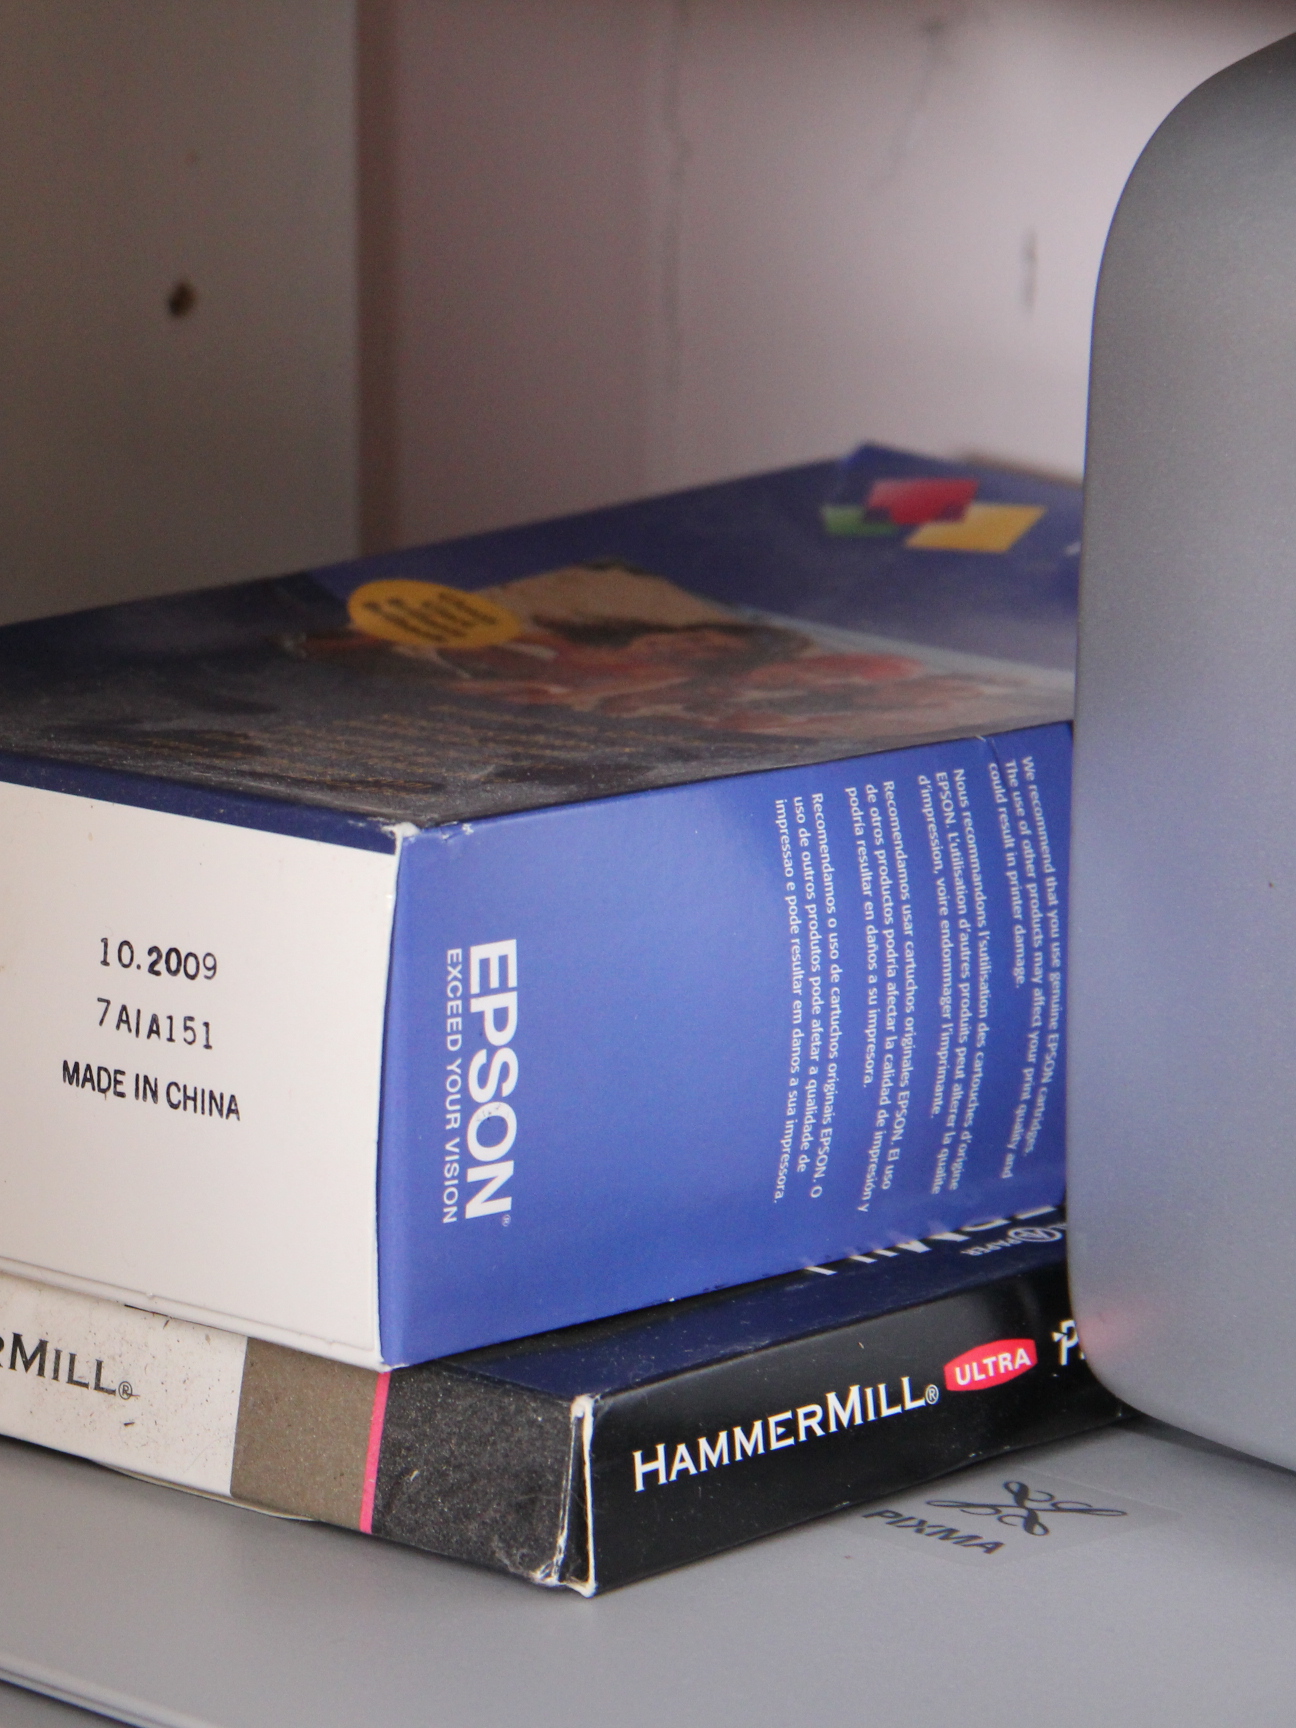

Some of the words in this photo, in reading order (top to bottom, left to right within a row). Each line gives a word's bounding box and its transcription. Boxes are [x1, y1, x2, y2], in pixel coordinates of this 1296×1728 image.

[952, 767, 969, 808] Nous
[987, 761, 1008, 804] could
[1004, 758, 1018, 787] The
[1020, 755, 1036, 781] We
[792, 795, 805, 824] uso
[843, 786, 865, 836] podría
[864, 783, 878, 803] de
[1011, 791, 1025, 816] use
[797, 827, 811, 847] de
[869, 806, 884, 846] otros
[882, 779, 910, 901] Recomendamos
[996, 806, 1015, 849] result
[1018, 820, 1032, 835] of
[1028, 784, 1055, 874] recommend
[811, 792, 835, 914] Recomendamos
[855, 839, 872, 897] resultar
[962, 810, 986, 928] recommandons
[1004, 851, 1017, 867] in
[1022, 839, 1036, 878] other
[785, 881, 796, 891] e
[801, 850, 815, 900] outros
[873, 849, 893, 925] productos
[1004, 869, 1022, 920] printer
[1044, 875, 1058, 906] that
[783, 894, 802, 934] pode
[862, 900, 874, 921] en
[934, 877, 950, 916] voire
[1025, 882, 1043, 948] products
[804, 903, 822, 972] produtos
[826, 917, 837, 929] o
[900, 903, 913, 937] usar
[1046, 909, 1058, 938] you
[100, 937, 217, 980] 10.2009
[827, 931, 839, 960] uso
[864, 924, 879, 971] daños
[881, 928, 898, 978] podría
[1011, 923, 1026, 989] damage.
[1050, 942, 1060, 967] use
[790, 938, 804, 996] resultar
[829, 963, 843, 983] de
[866, 974, 878, 984] a
[903, 940, 917, 1013] cartuchos
[938, 918, 953, 1019] endommager
[1030, 951, 1043, 983] may
[446, 948, 463, 1051] EXCEED
[791, 999, 802, 1024] em
[808, 975, 824, 1015] pode
[866, 986, 878, 1005] su
[885, 981, 899, 1032] afectar
[957, 982, 972, 1043] produits
[1029, 987, 1045, 1028] affect
[1048, 972, 1060, 1029] genuine
[809, 1018, 823, 1062] afetar
[827, 986, 842, 1059] cartuchos
[883, 1035, 898, 1050] la
[975, 1021, 990, 1048] des
[789, 1027, 804, 1074] danos
[862, 1008, 880, 1088] impresora.
[899, 1016, 916, 1088] originales
[954, 1046, 966, 1079] peut
[1025, 1030, 1039, 1063] your
[1040, 1033, 1058, 1084] EPSON
[62, 1059, 126, 1098] MADE
[134, 1073, 158, 1104] IN
[165, 1081, 241, 1121] CHINA
[787, 1077, 799, 1087] a
[807, 1065, 818, 1075] a
[877, 1053, 895, 1106] calidad
[963, 1050, 984, 1128] cartouches
[1019, 1066, 1034, 1101] print
[445, 1057, 462, 1130] YOUR
[785, 1089, 798, 1116] sua
[821, 1061, 839, 1125] originais
[800, 1078, 817, 1150] qualidade
[874, 1108, 889, 1127] de
[1006, 1103, 1026, 1150] quality
[886, 1146, 900, 1162] El
[941, 1130, 956, 1145] la
[443, 1137, 461, 1224] VISION
[773, 1118, 797, 1204] impressora.
[796, 1153, 810, 1172] de
[876, 1164, 894, 1190] uso
[999, 1152, 1015, 1179] and
[808, 1184, 823, 1198] O
[855, 1202, 870, 1212] y
[955, 1347, 1031, 1386] ULTRA
[862, 1509, 1004, 1554] PIXMA
